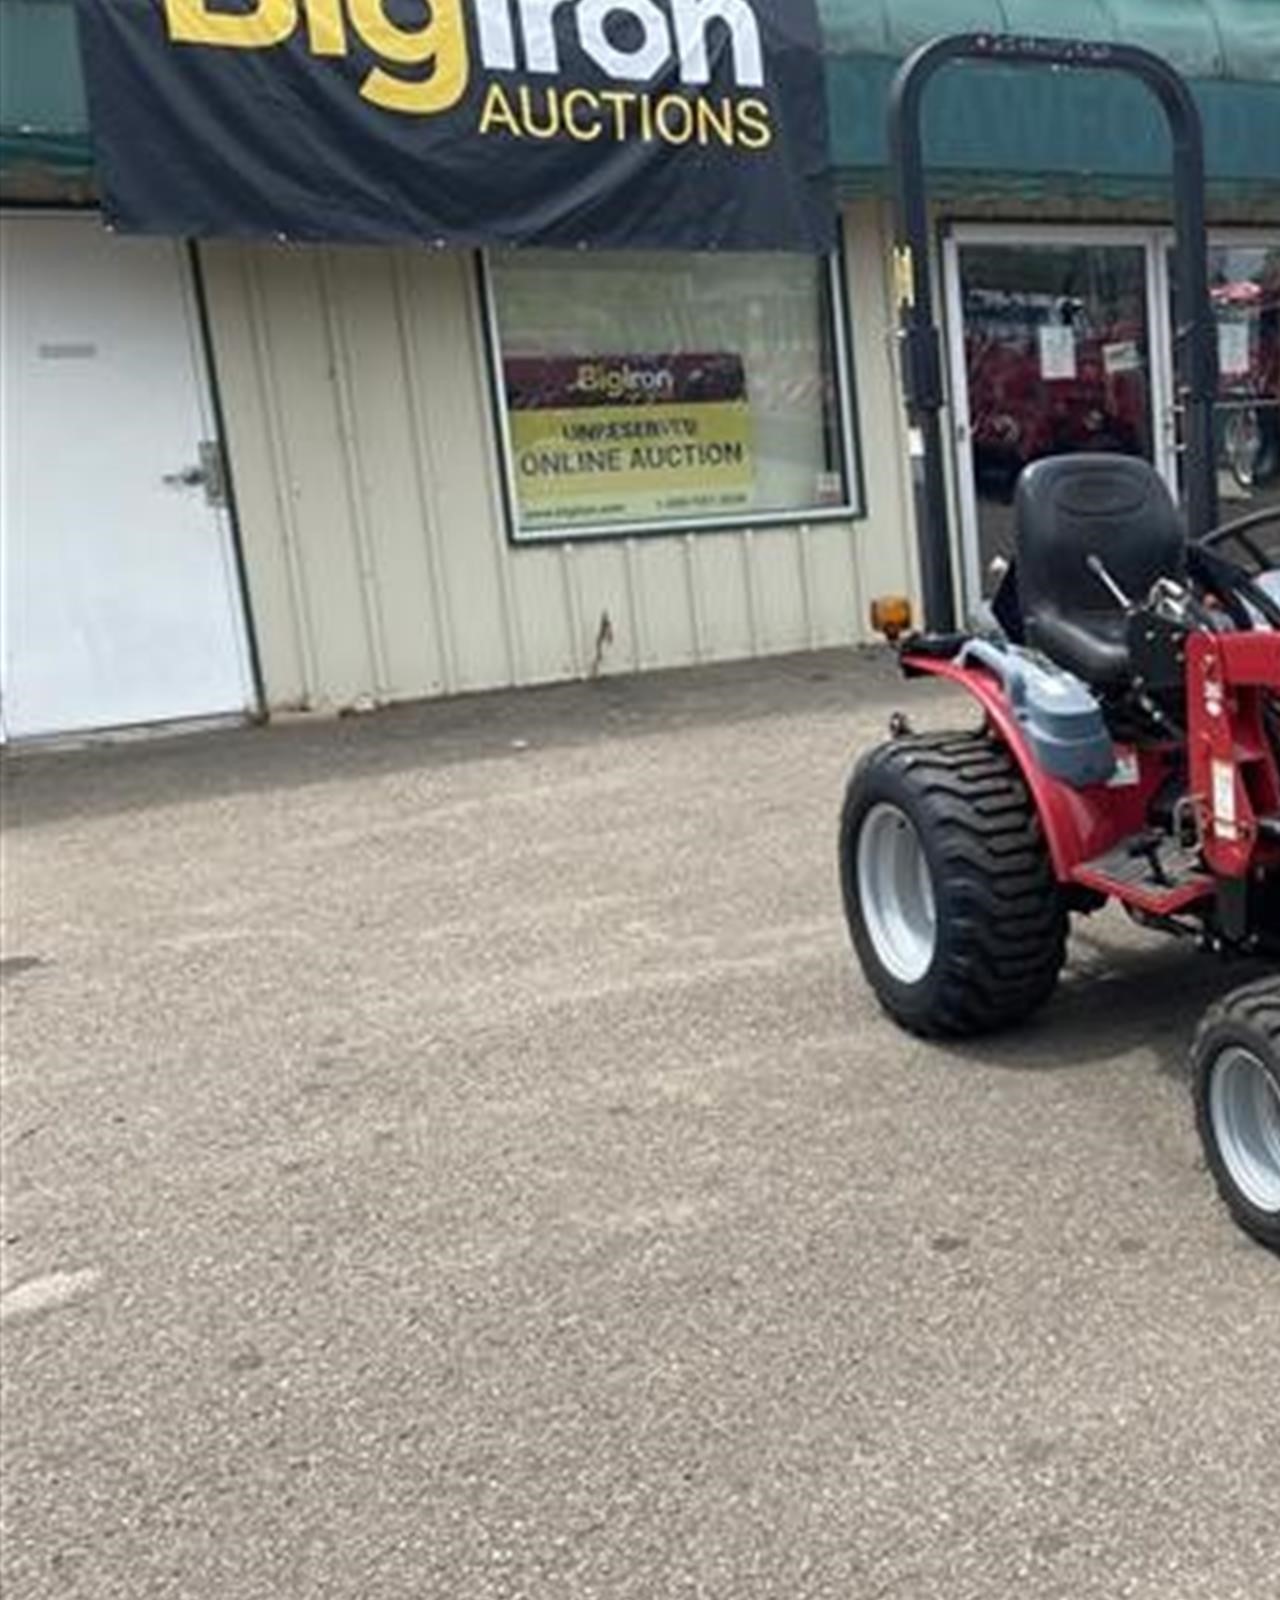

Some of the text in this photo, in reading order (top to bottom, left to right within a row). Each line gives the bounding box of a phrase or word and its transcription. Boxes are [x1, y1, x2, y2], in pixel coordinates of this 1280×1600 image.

[478, 81, 772, 148] AUCTIONS
[577, 362, 675, 399] BigIron
[520, 441, 743, 477] ONLINE AUCTION
